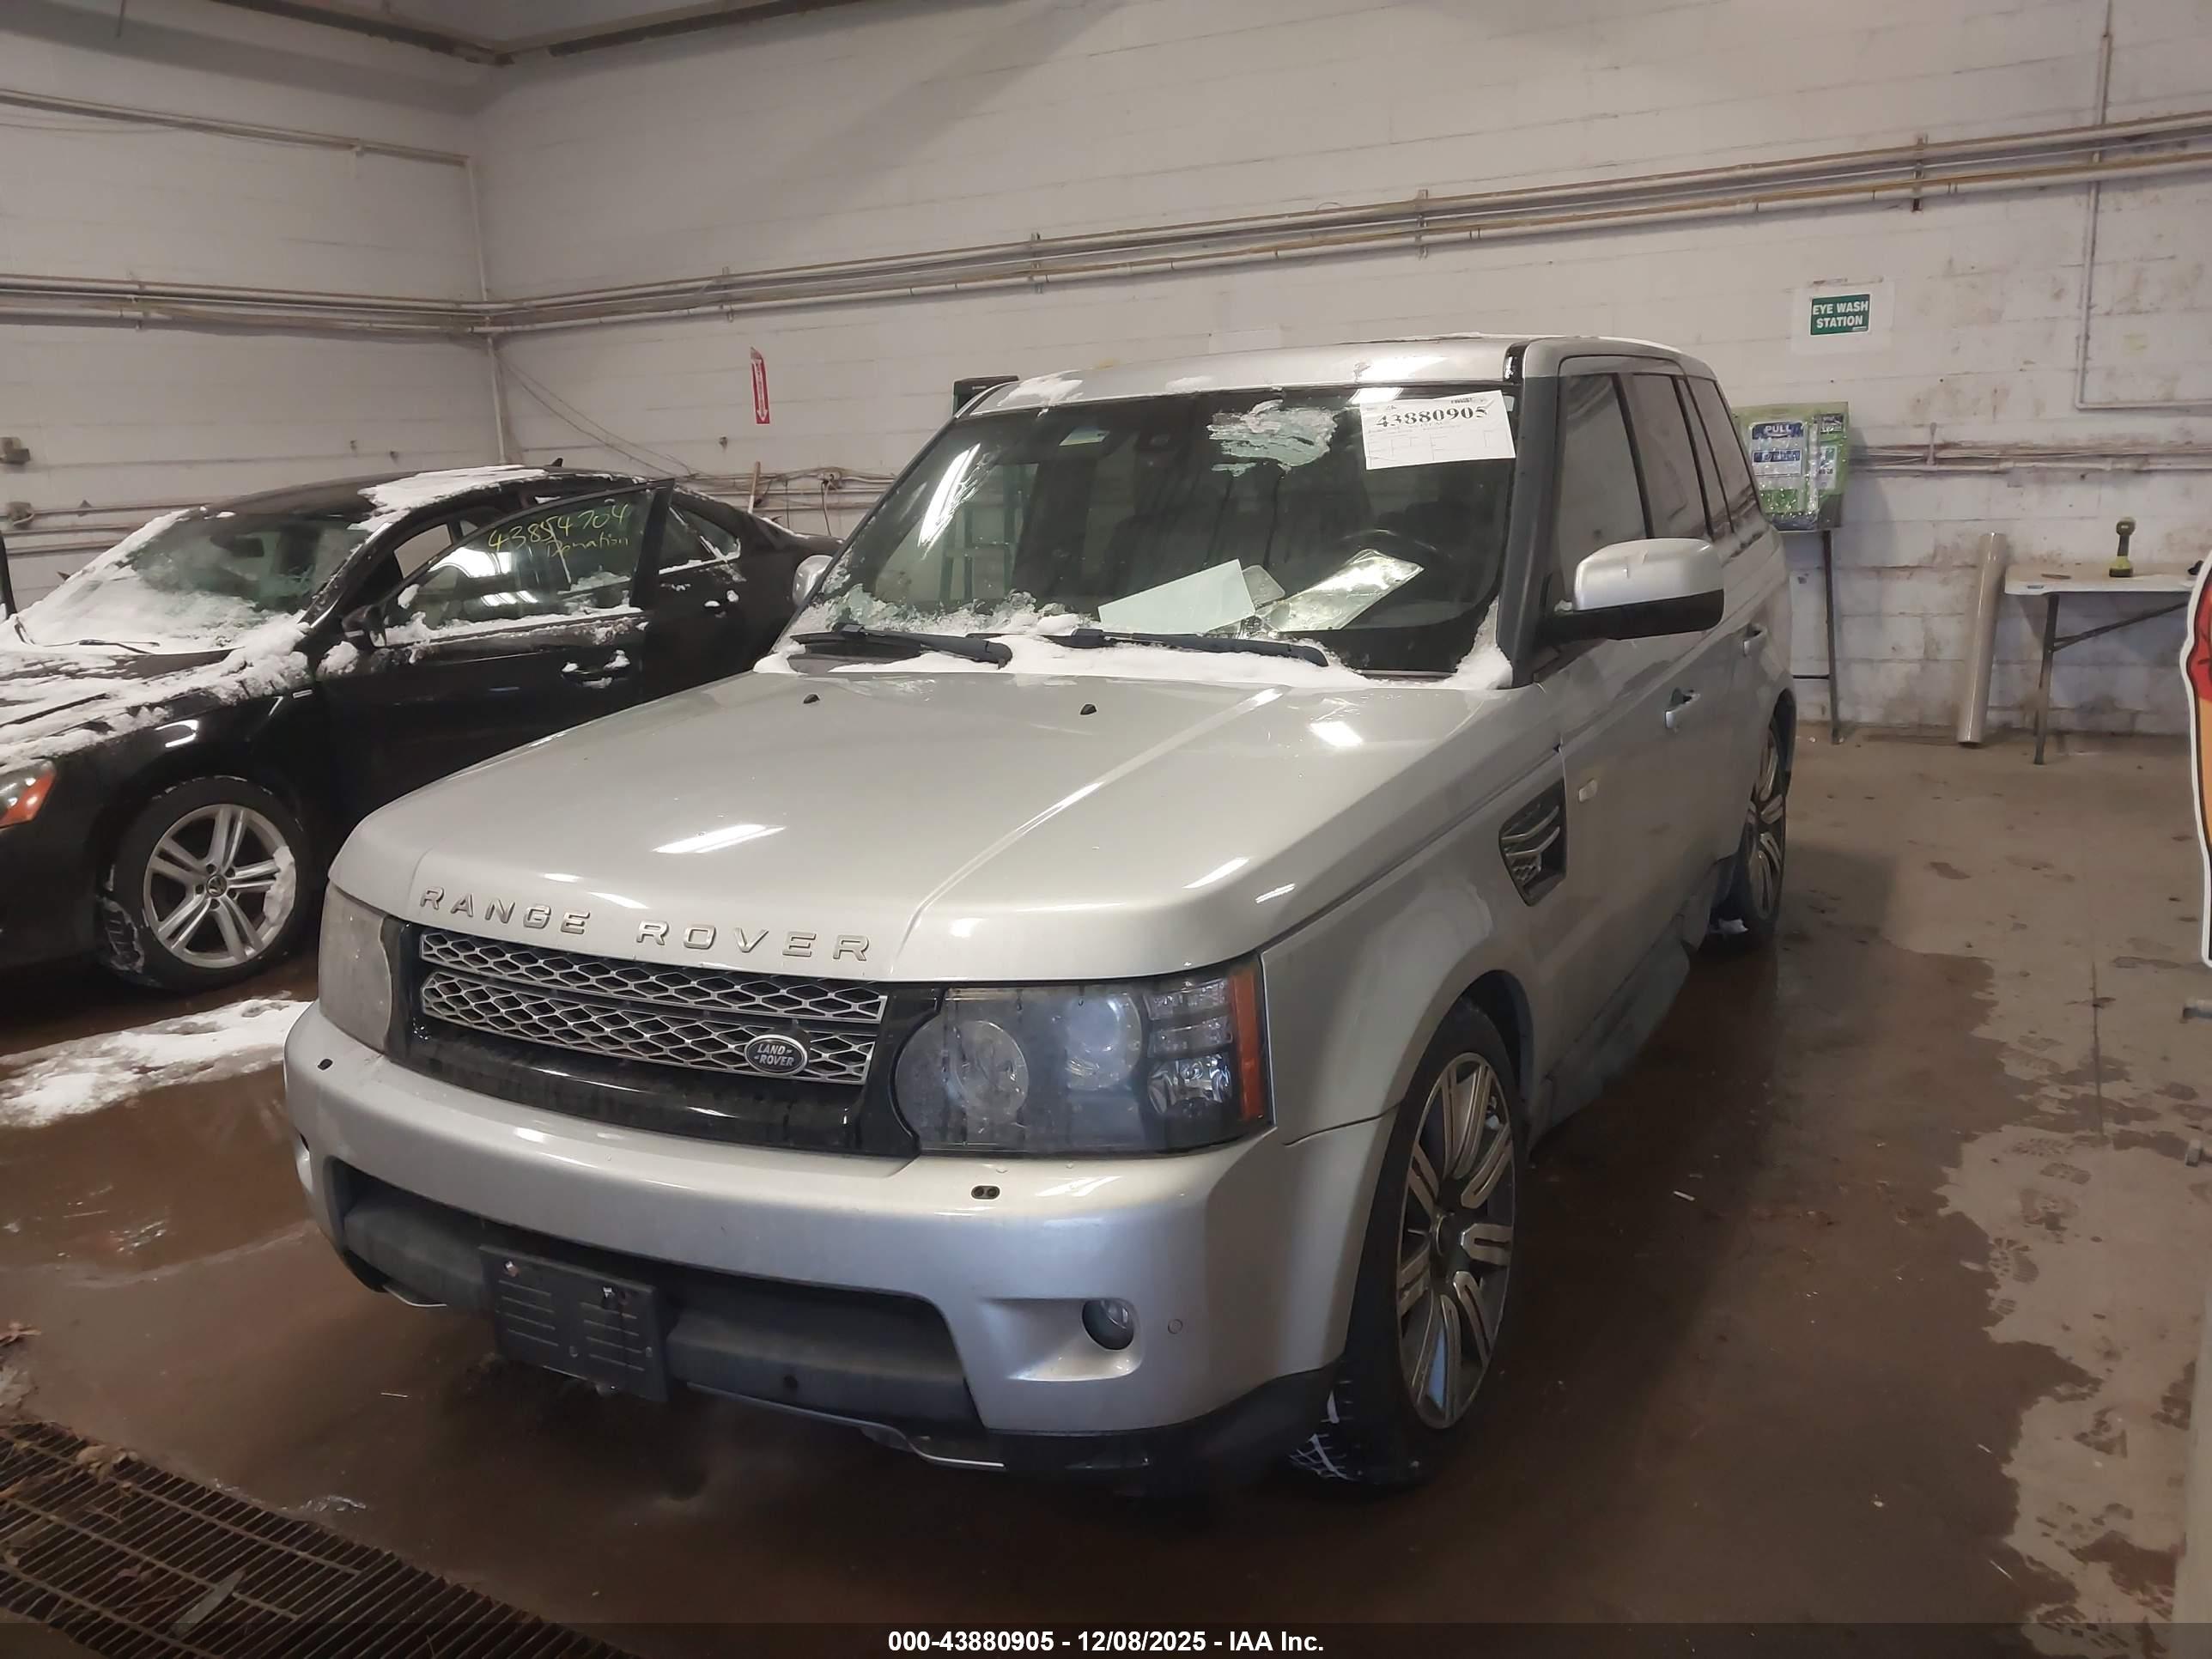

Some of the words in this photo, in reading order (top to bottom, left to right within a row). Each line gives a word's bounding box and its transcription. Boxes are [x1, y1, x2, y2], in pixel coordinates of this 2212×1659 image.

[1813, 303, 1834, 315] EYE
[1836, 301, 1869, 313] WASH
[1816, 315, 1863, 329] STATION
[1376, 406, 1488, 428] 43880905
[1765, 424, 1792, 434] PULL
[488, 501, 629, 551] 43854704
[420, 886, 590, 935] RANGE
[635, 920, 870, 962] ROVER
